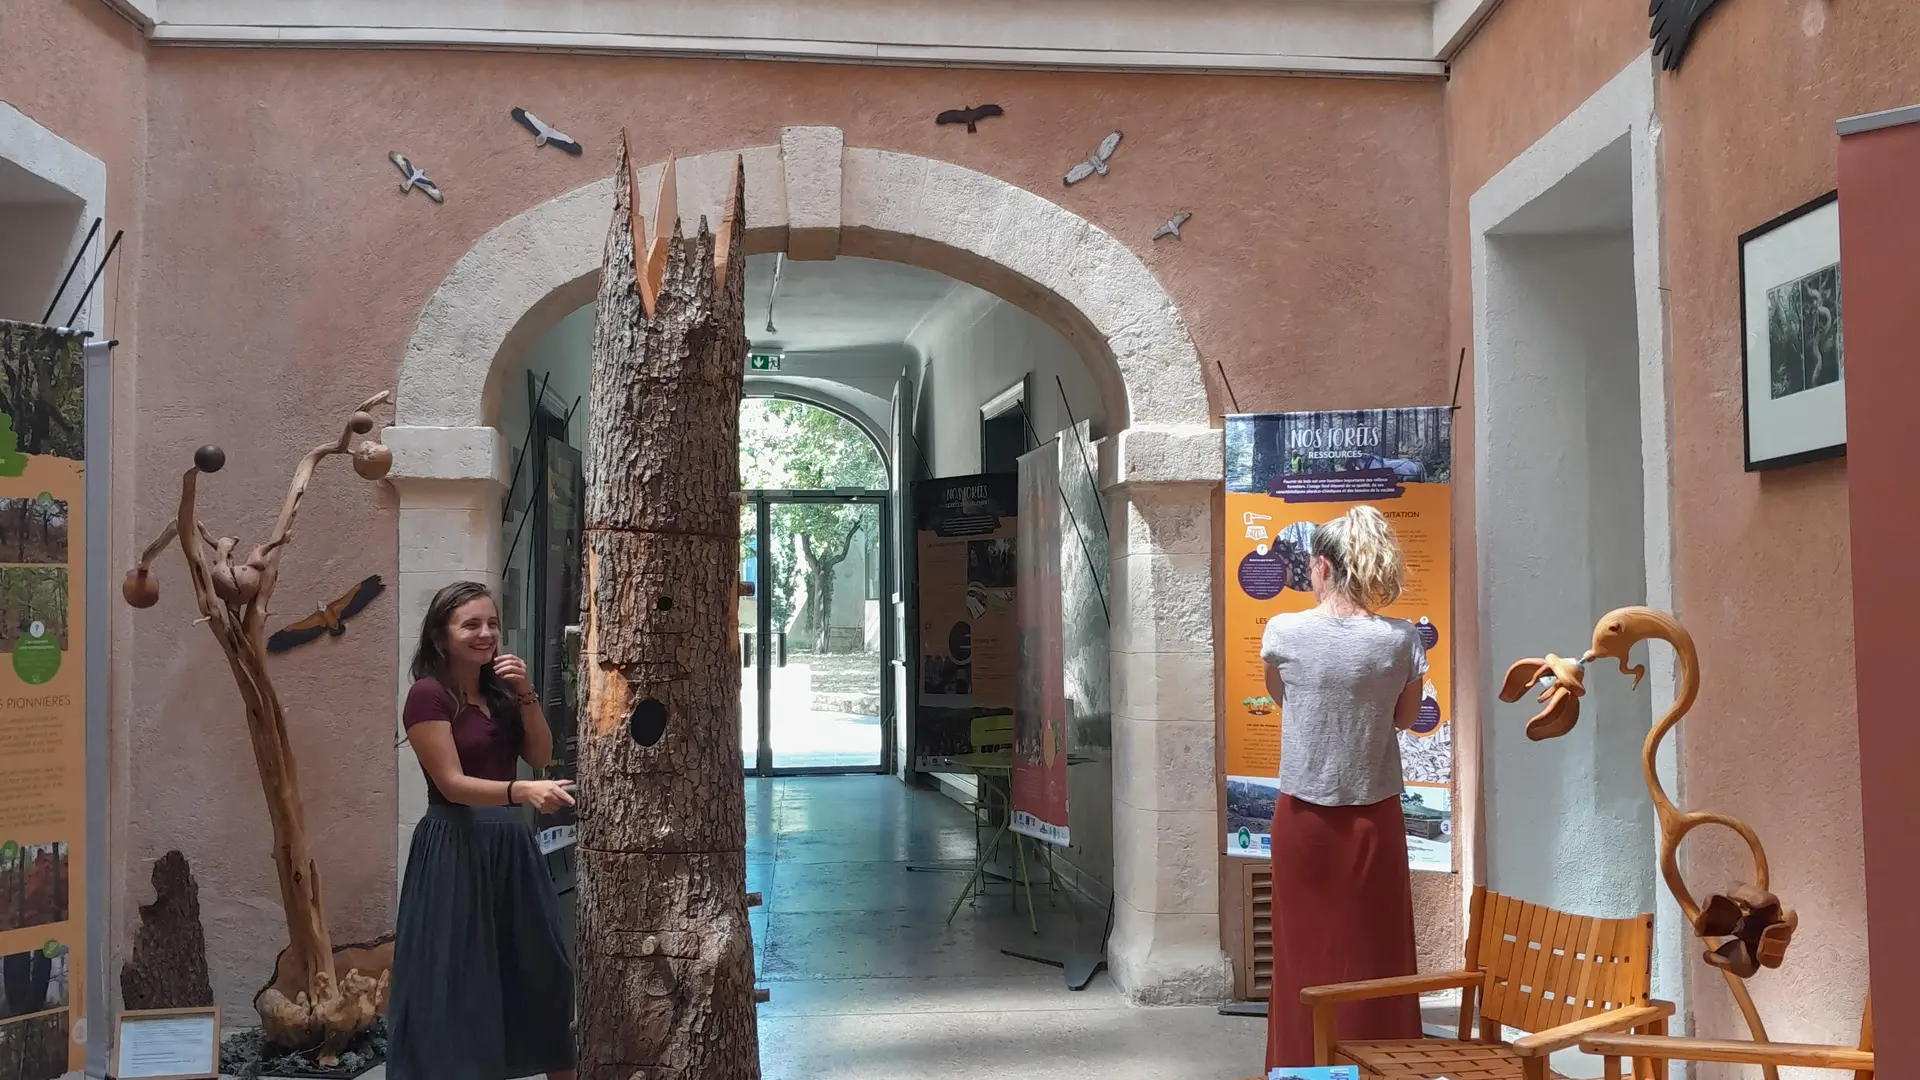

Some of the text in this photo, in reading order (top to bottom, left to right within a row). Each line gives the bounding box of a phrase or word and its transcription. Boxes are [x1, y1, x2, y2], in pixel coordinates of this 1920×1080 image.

[1291, 423, 1379, 449] NOS FORÊTS
[1308, 450, 1363, 459] RESSOURCES
[1255, 617, 1268, 625] LES
[1443, 823, 1449, 832] 3
